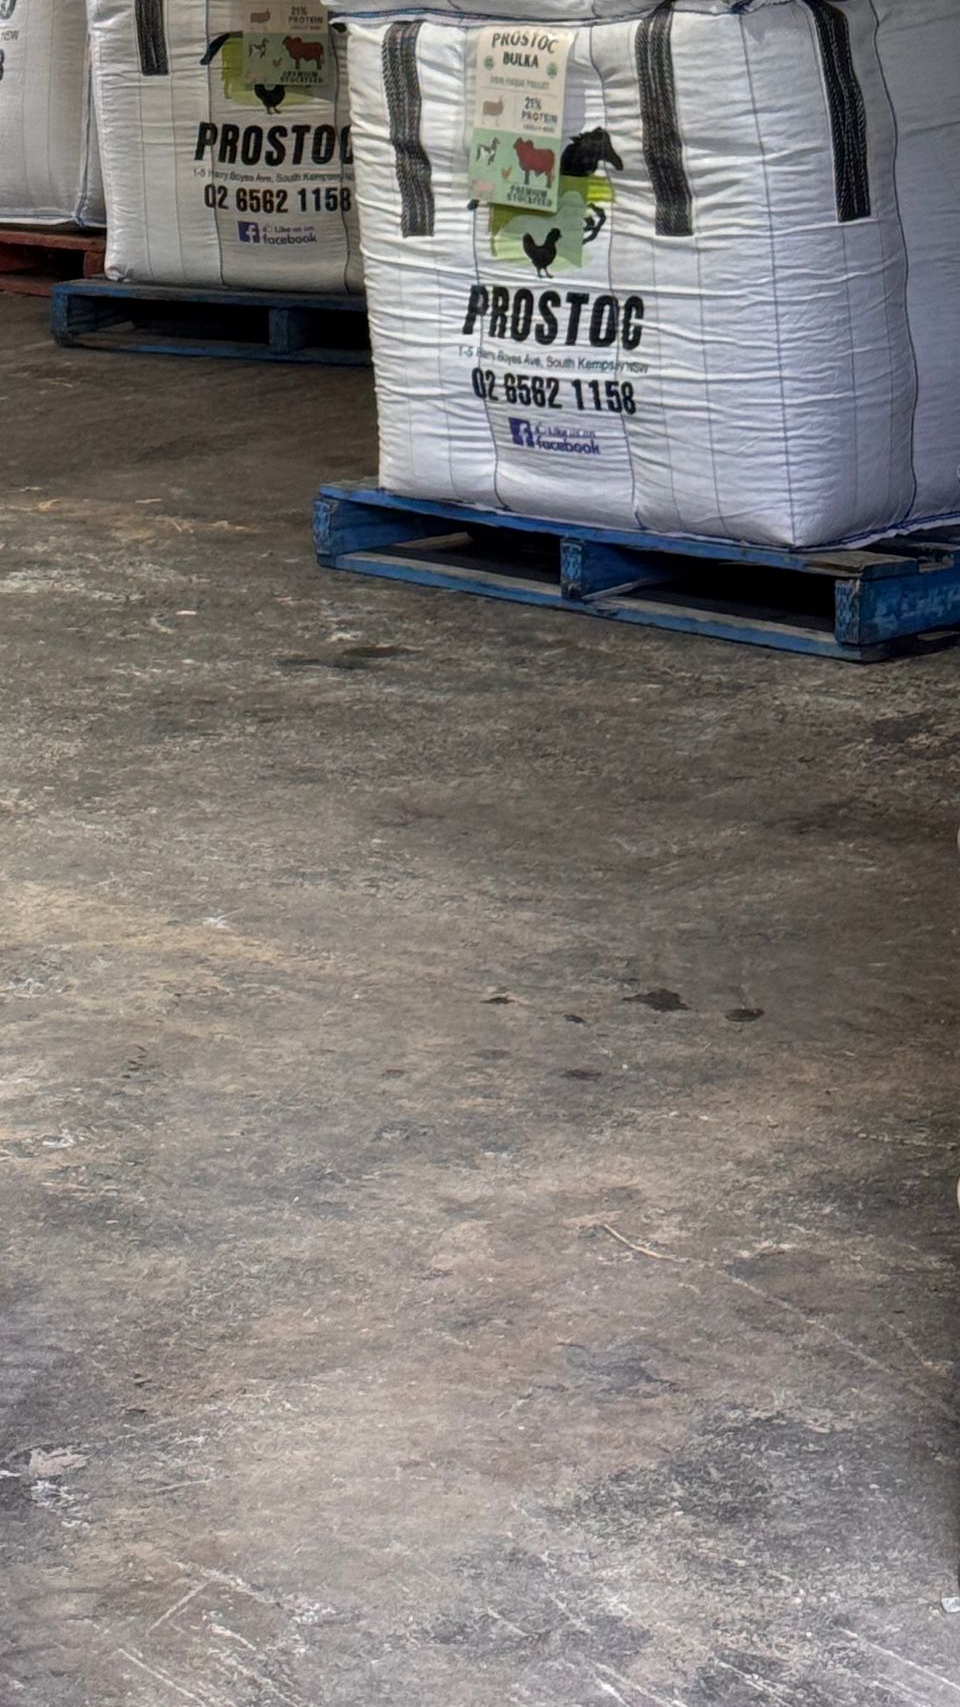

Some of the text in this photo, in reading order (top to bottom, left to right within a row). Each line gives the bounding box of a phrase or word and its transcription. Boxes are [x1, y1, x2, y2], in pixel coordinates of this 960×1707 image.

[492, 31, 559, 54] PROSTOC
[503, 51, 539, 69] BULKA
[522, 110, 558, 123] PROTEIN
[275, 173, 302, 183] South
[204, 184, 351, 213] 02 6562 1158
[262, 233, 318, 244] facebook
[462, 285, 644, 351] PROSTOC
[546, 355, 575, 369] South
[471, 367, 636, 415] 02 6562 1158
[536, 437, 600, 455] facebook
